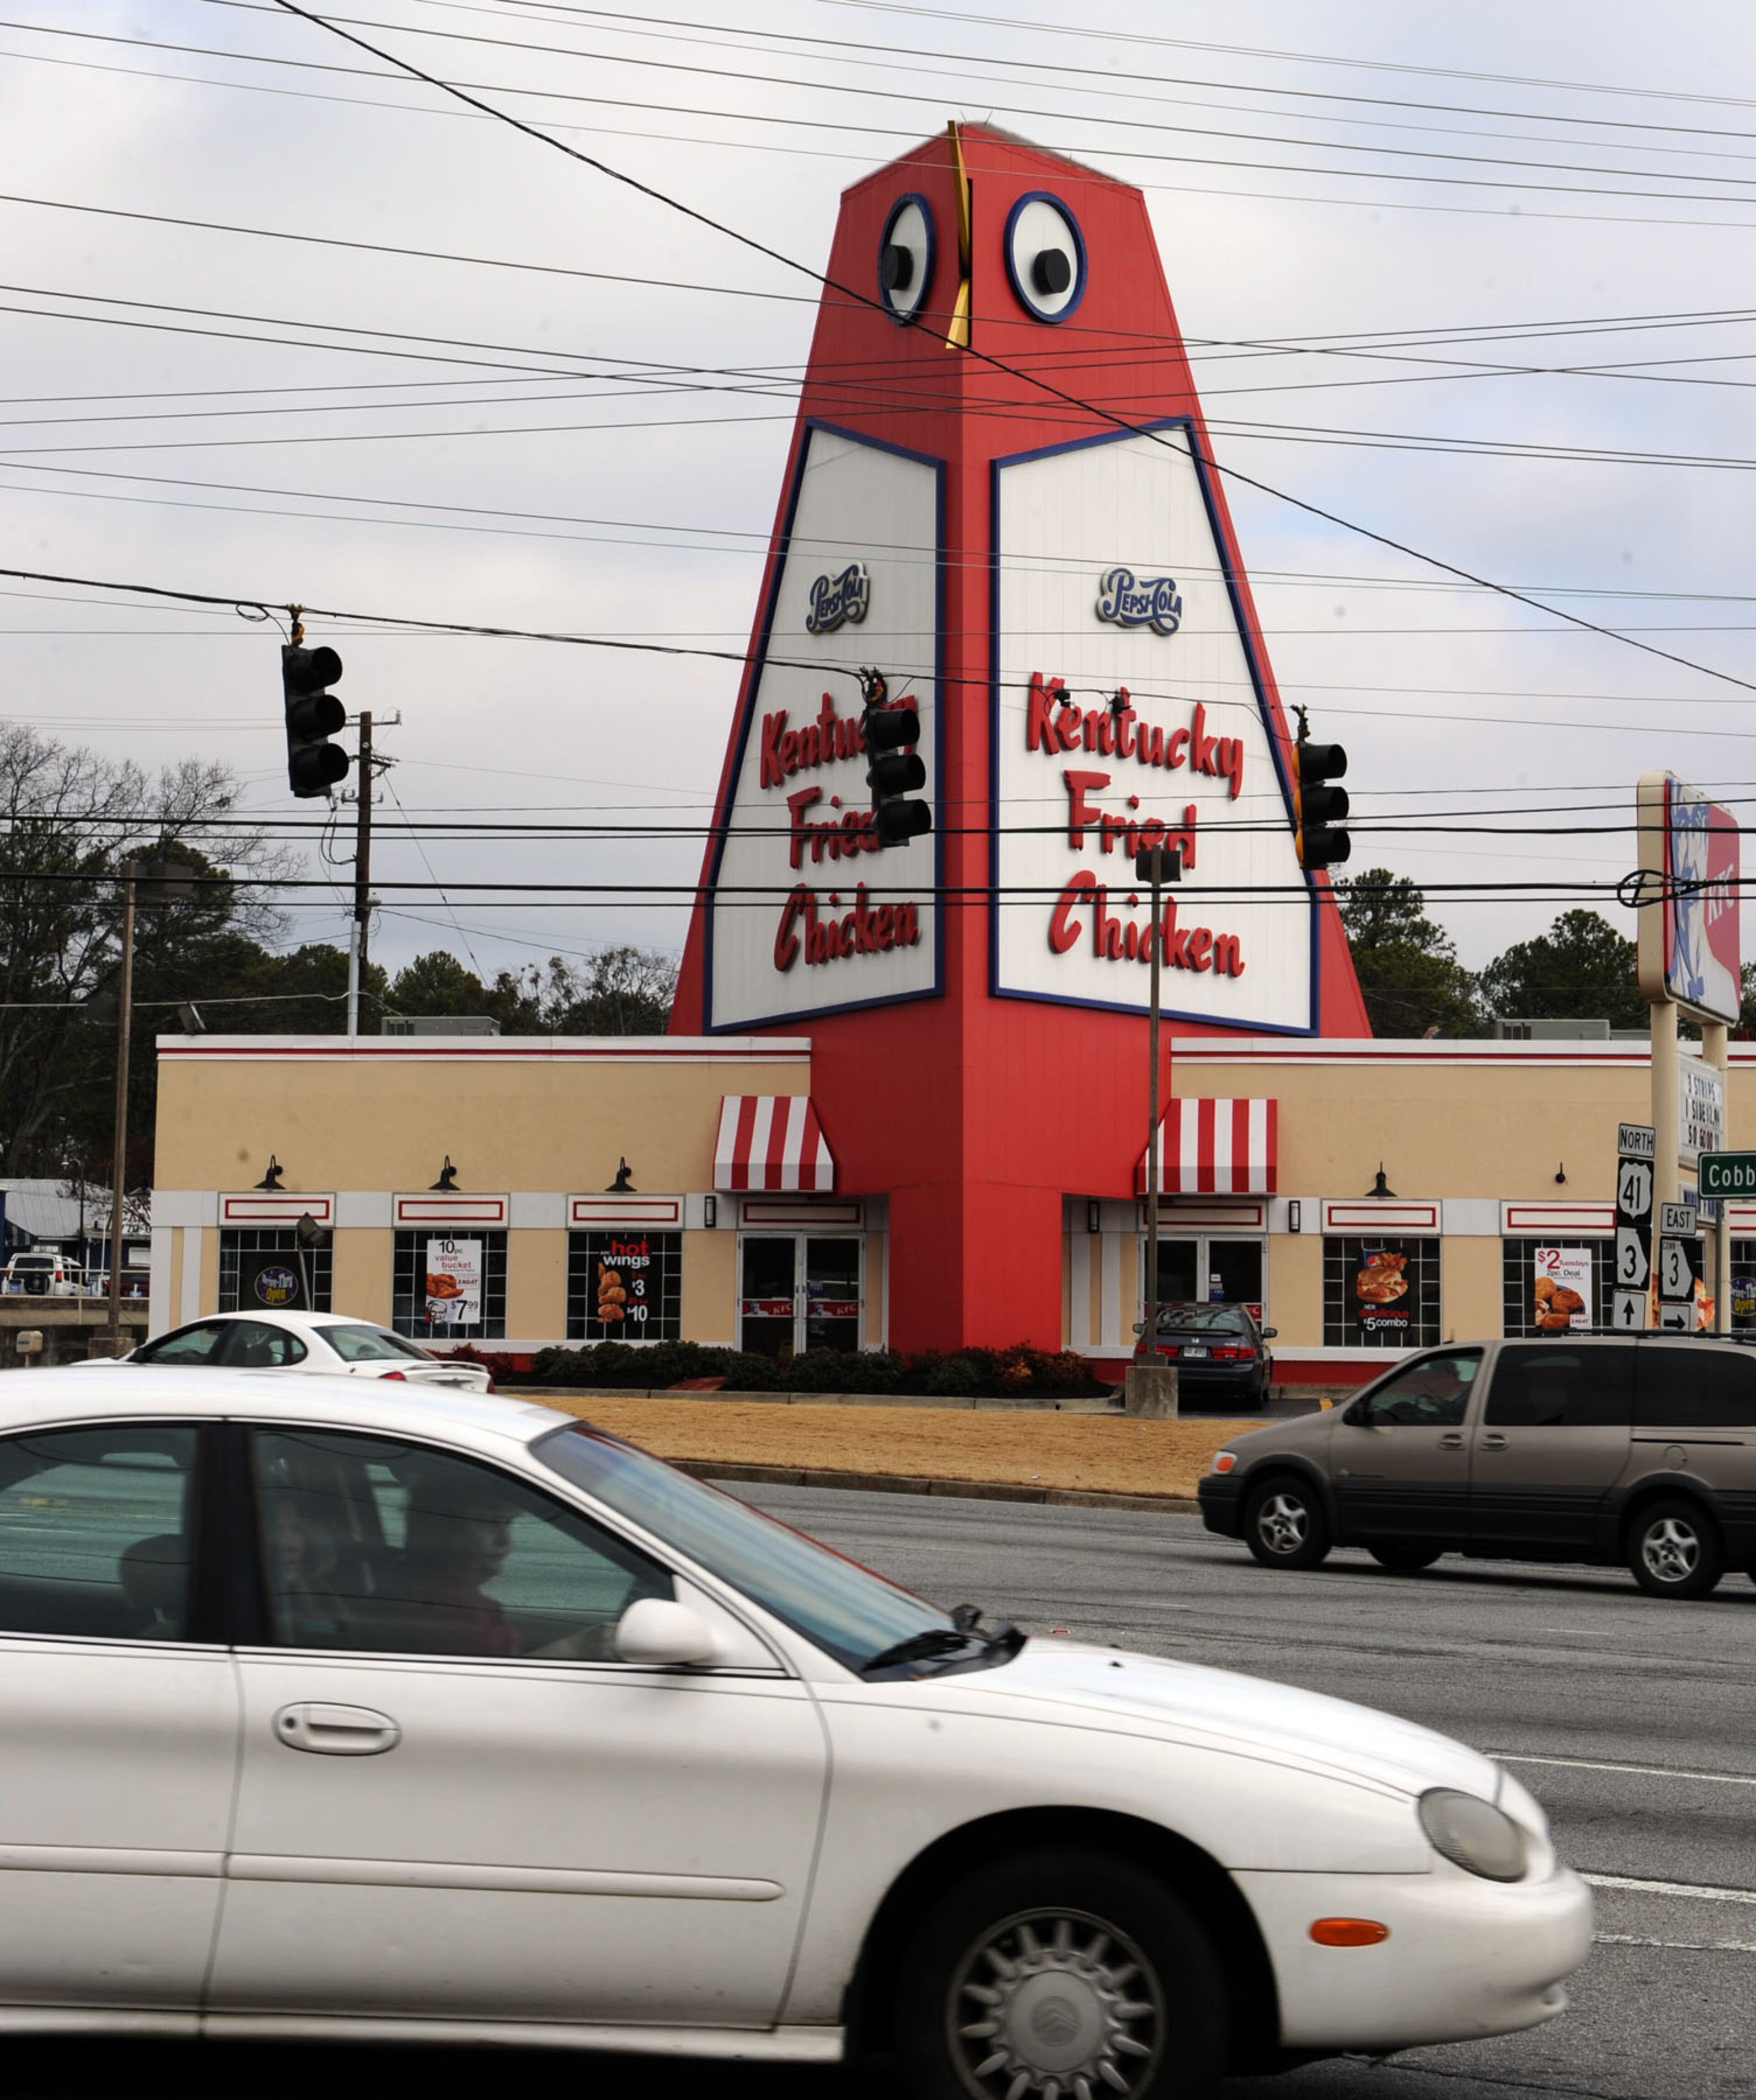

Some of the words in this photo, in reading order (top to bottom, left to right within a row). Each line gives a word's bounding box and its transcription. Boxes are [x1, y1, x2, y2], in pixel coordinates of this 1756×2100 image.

[760, 692, 915, 790] Kentu
[1028, 672, 1243, 800] Kentucky
[1064, 769, 1197, 869] Fried
[774, 882, 919, 972] Chicken
[1049, 870, 1245, 978] Chicken
[1620, 1128, 1654, 1152] NORTH
[1709, 1164, 1756, 1187] Cobb
[1622, 1175, 1641, 1209] 41
[1666, 1208, 1691, 1228] EAST
[611, 1240, 649, 1255] hot
[1538, 1249, 1560, 1269] $2
[1624, 1245, 1636, 1278] 3
[603, 1256, 650, 1269] wings
[1670, 1252, 1679, 1287] 3
[836, 1304, 856, 1315] KFC
[1376, 1317, 1408, 1327] combo
